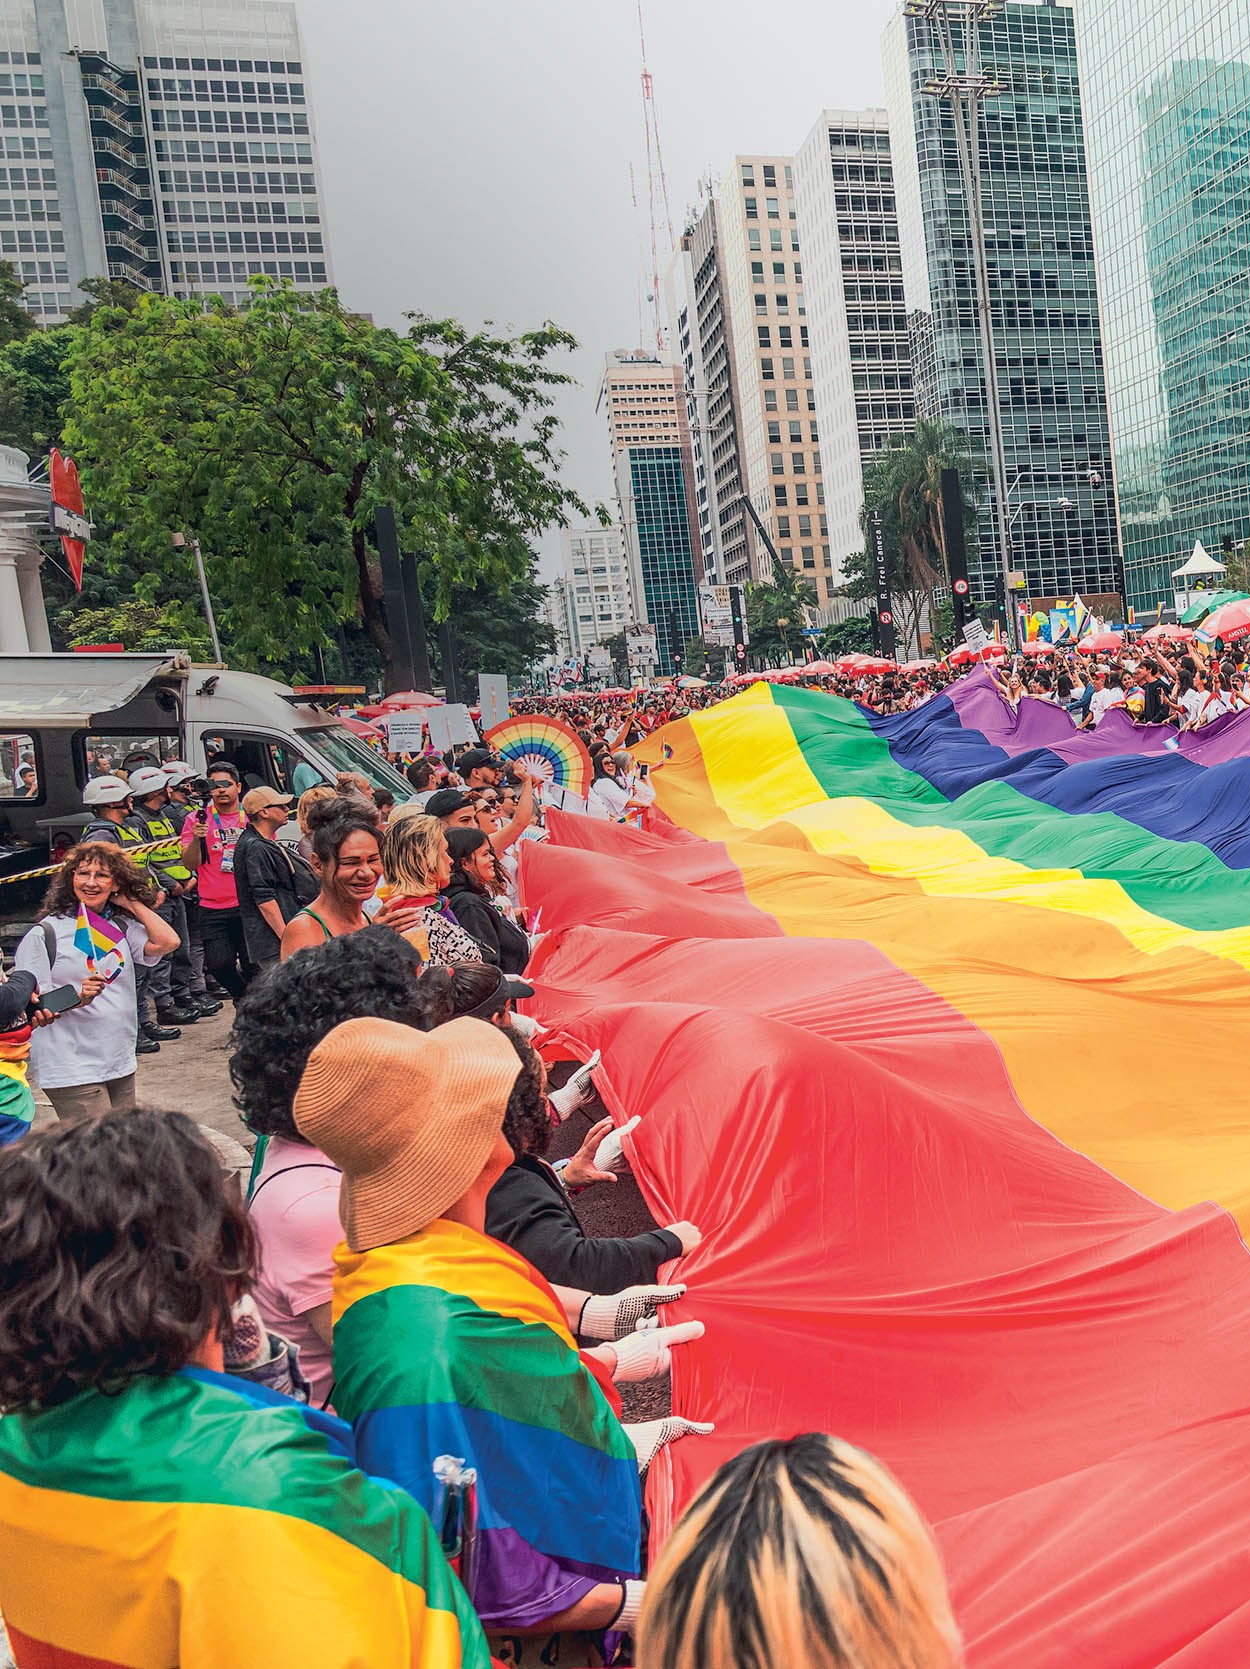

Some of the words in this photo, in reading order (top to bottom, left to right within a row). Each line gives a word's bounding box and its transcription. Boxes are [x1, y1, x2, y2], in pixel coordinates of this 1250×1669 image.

[875, 529, 884, 562] Caneca
[878, 566, 886, 586] Frei
[880, 589, 888, 600] R.
[1227, 627, 1249, 640] AMSTEL
